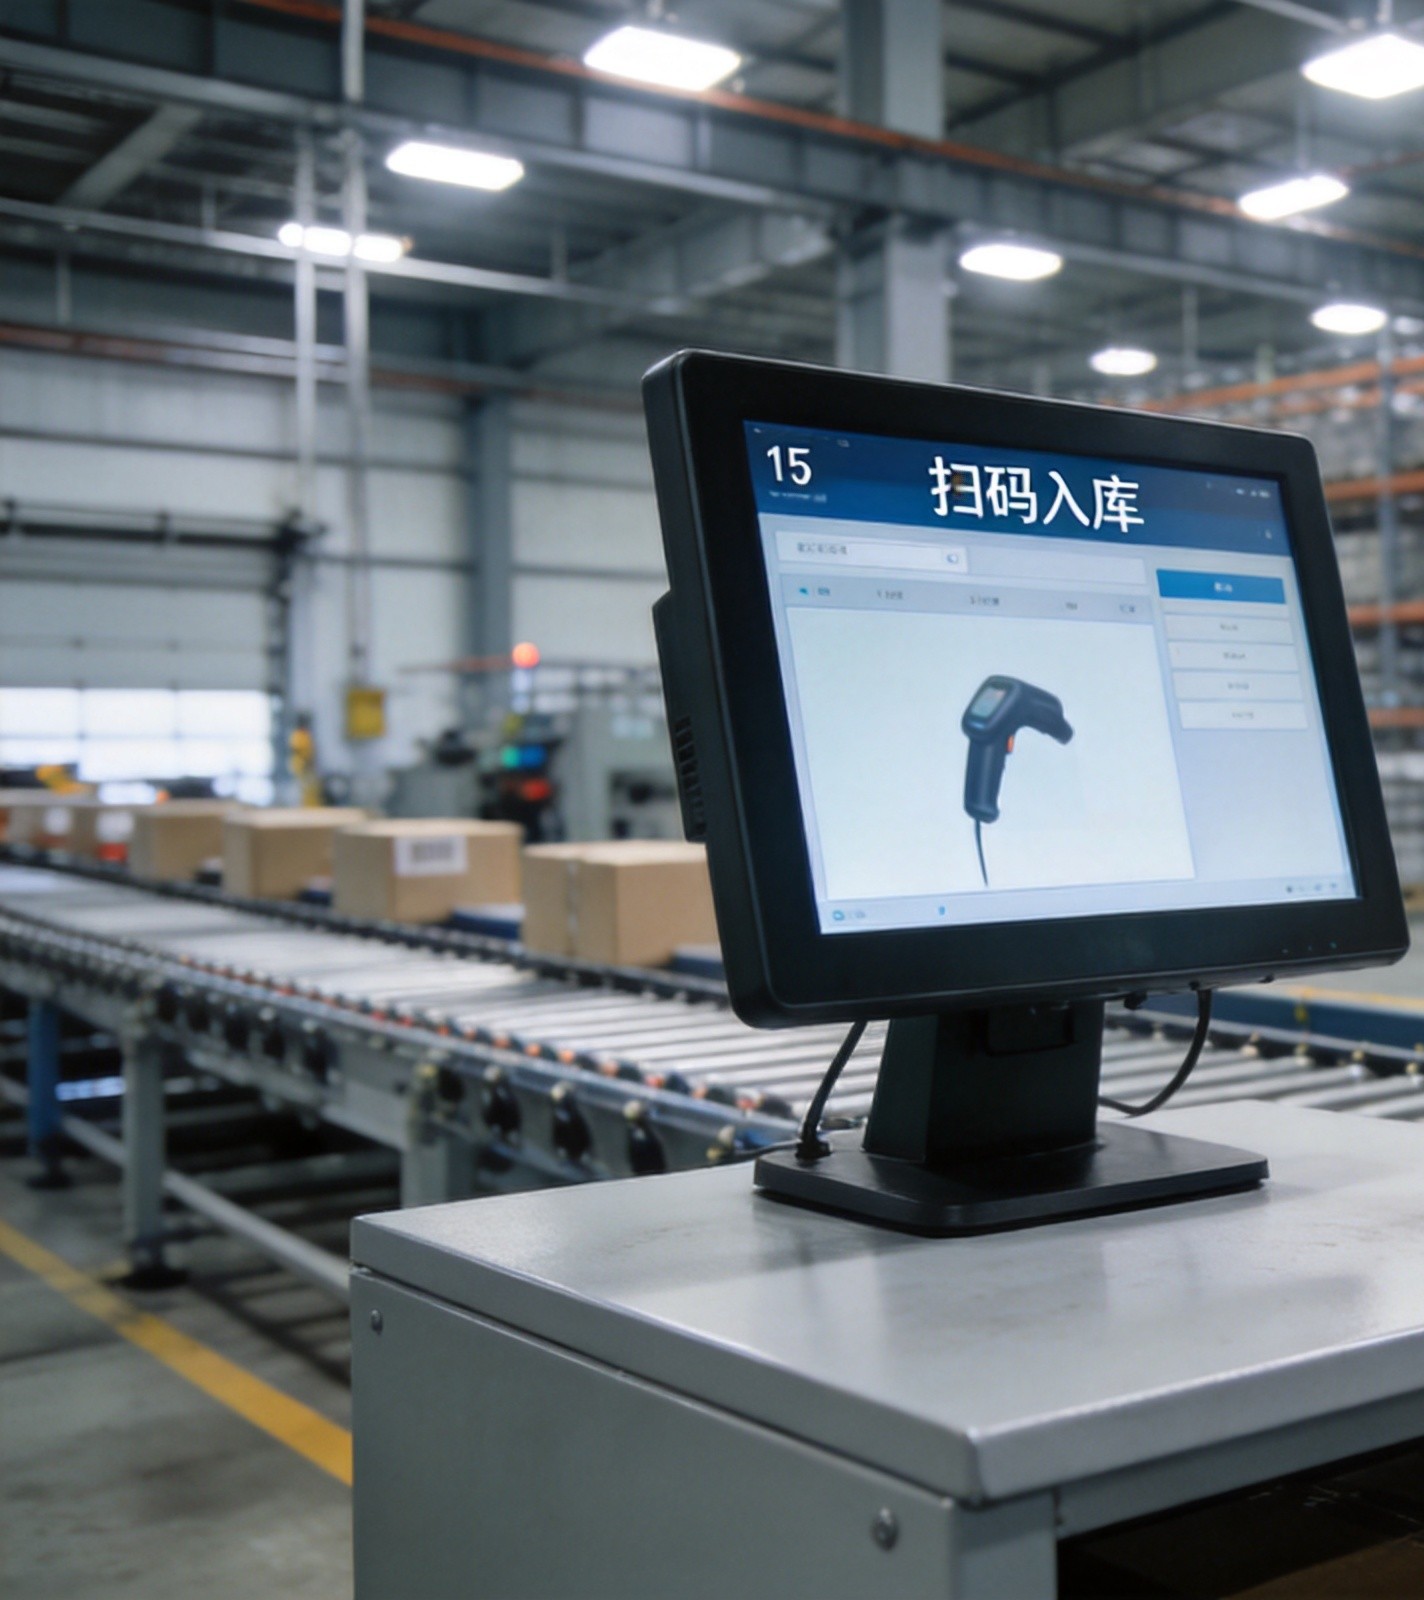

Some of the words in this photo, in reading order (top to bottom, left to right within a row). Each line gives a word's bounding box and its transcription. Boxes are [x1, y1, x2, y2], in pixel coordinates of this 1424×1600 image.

[767, 445, 812, 486] 15
[928, 456, 1145, 533] 扫码入库
